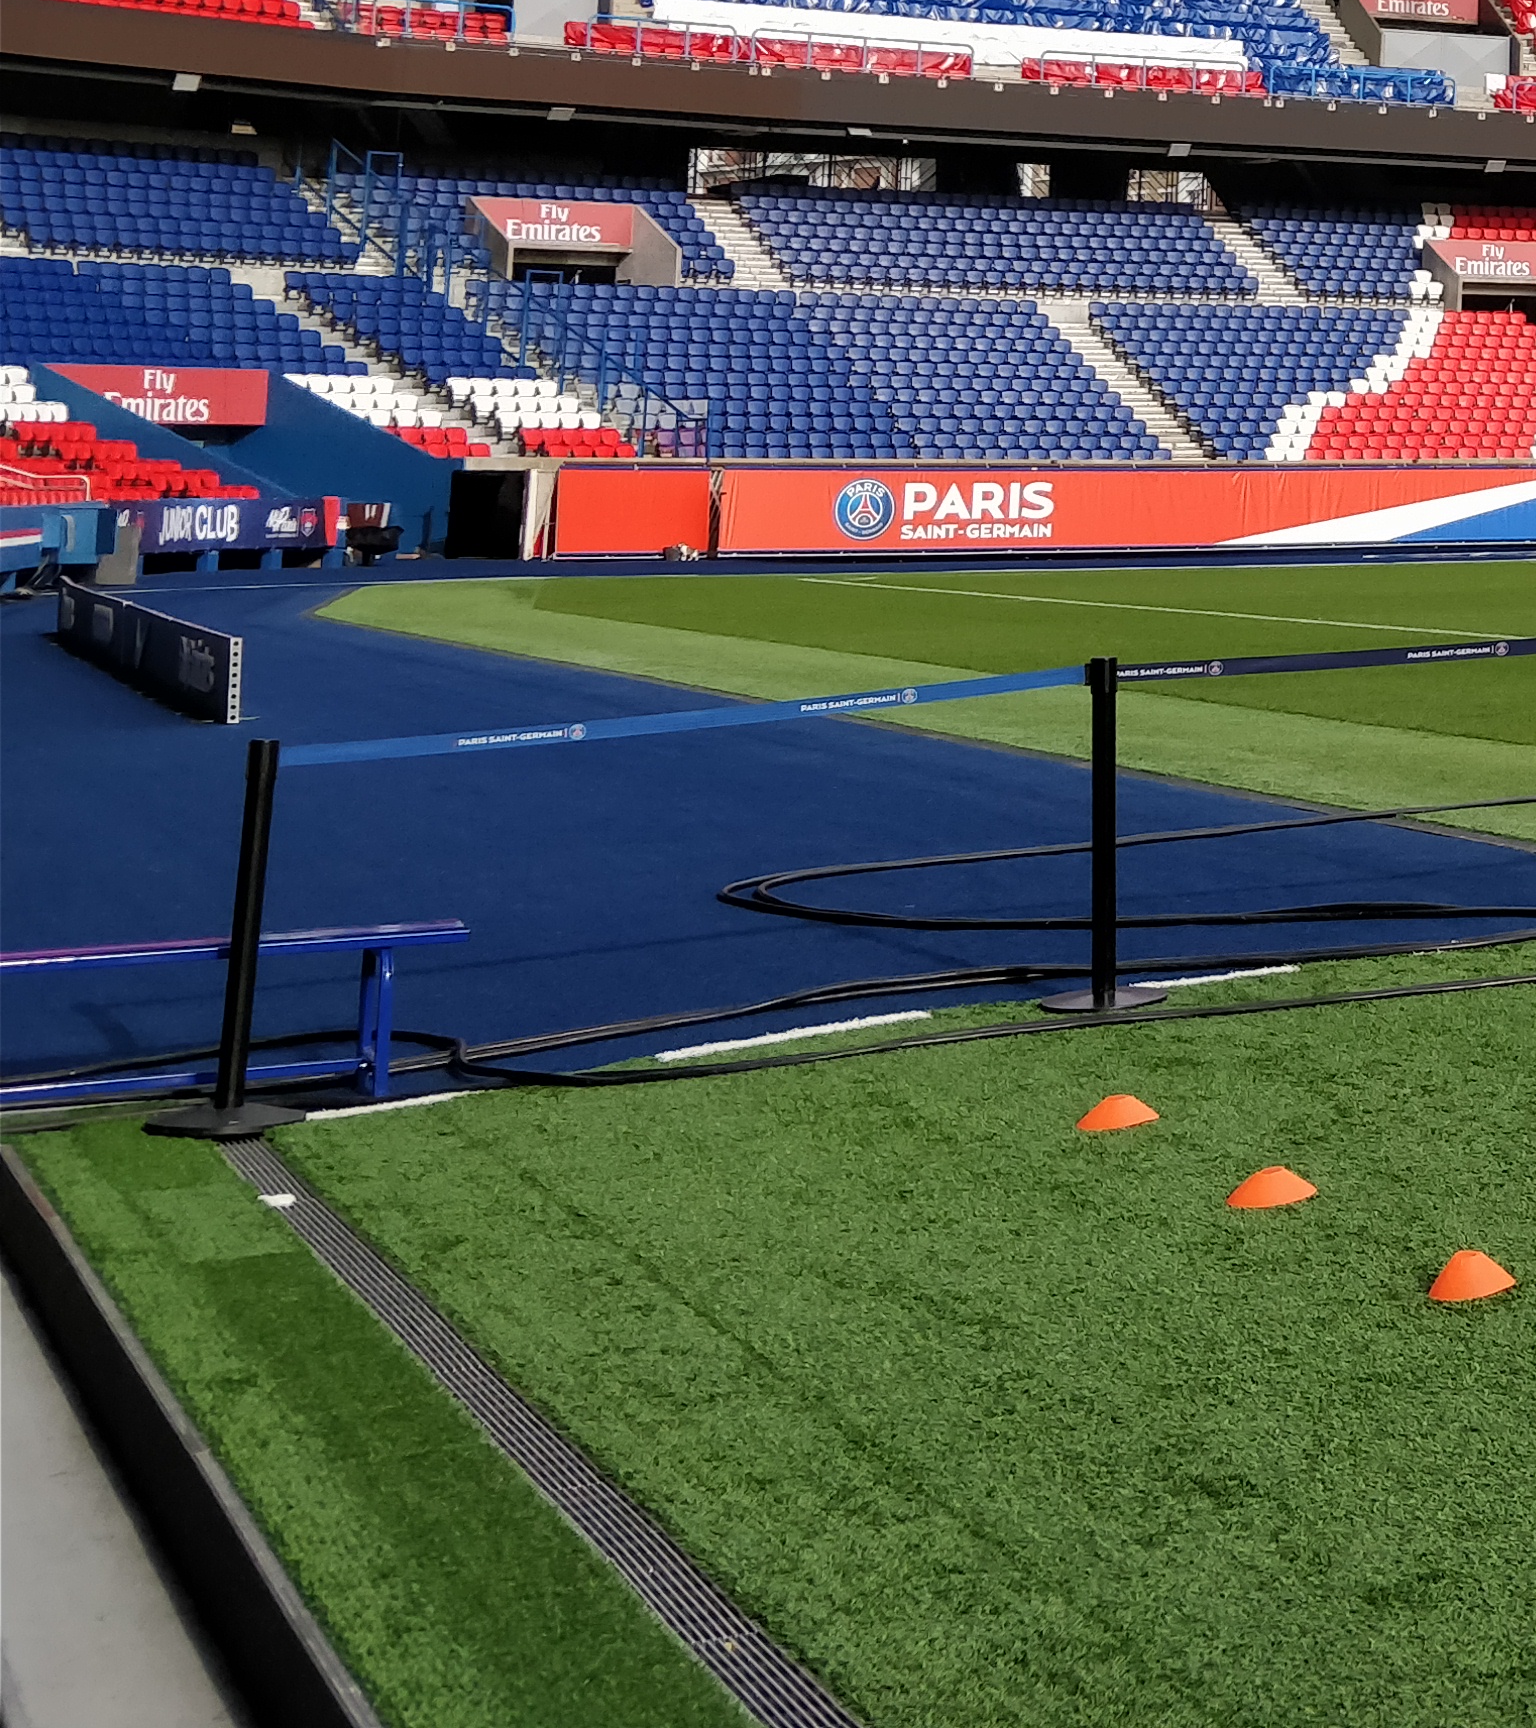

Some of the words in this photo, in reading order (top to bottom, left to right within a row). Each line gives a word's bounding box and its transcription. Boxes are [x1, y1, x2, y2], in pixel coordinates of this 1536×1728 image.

[540, 203, 570, 222] Fly
[506, 218, 601, 242] Emirates
[1482, 244, 1504, 259] Fly
[1455, 256, 1530, 276] Emirates
[143, 369, 176, 393] Fly
[847, 482, 885, 497] PARIS
[903, 481, 1055, 521] PARIS
[195, 503, 239, 542] CLUB
[900, 522, 1052, 540] SAINT-GERMAIN
